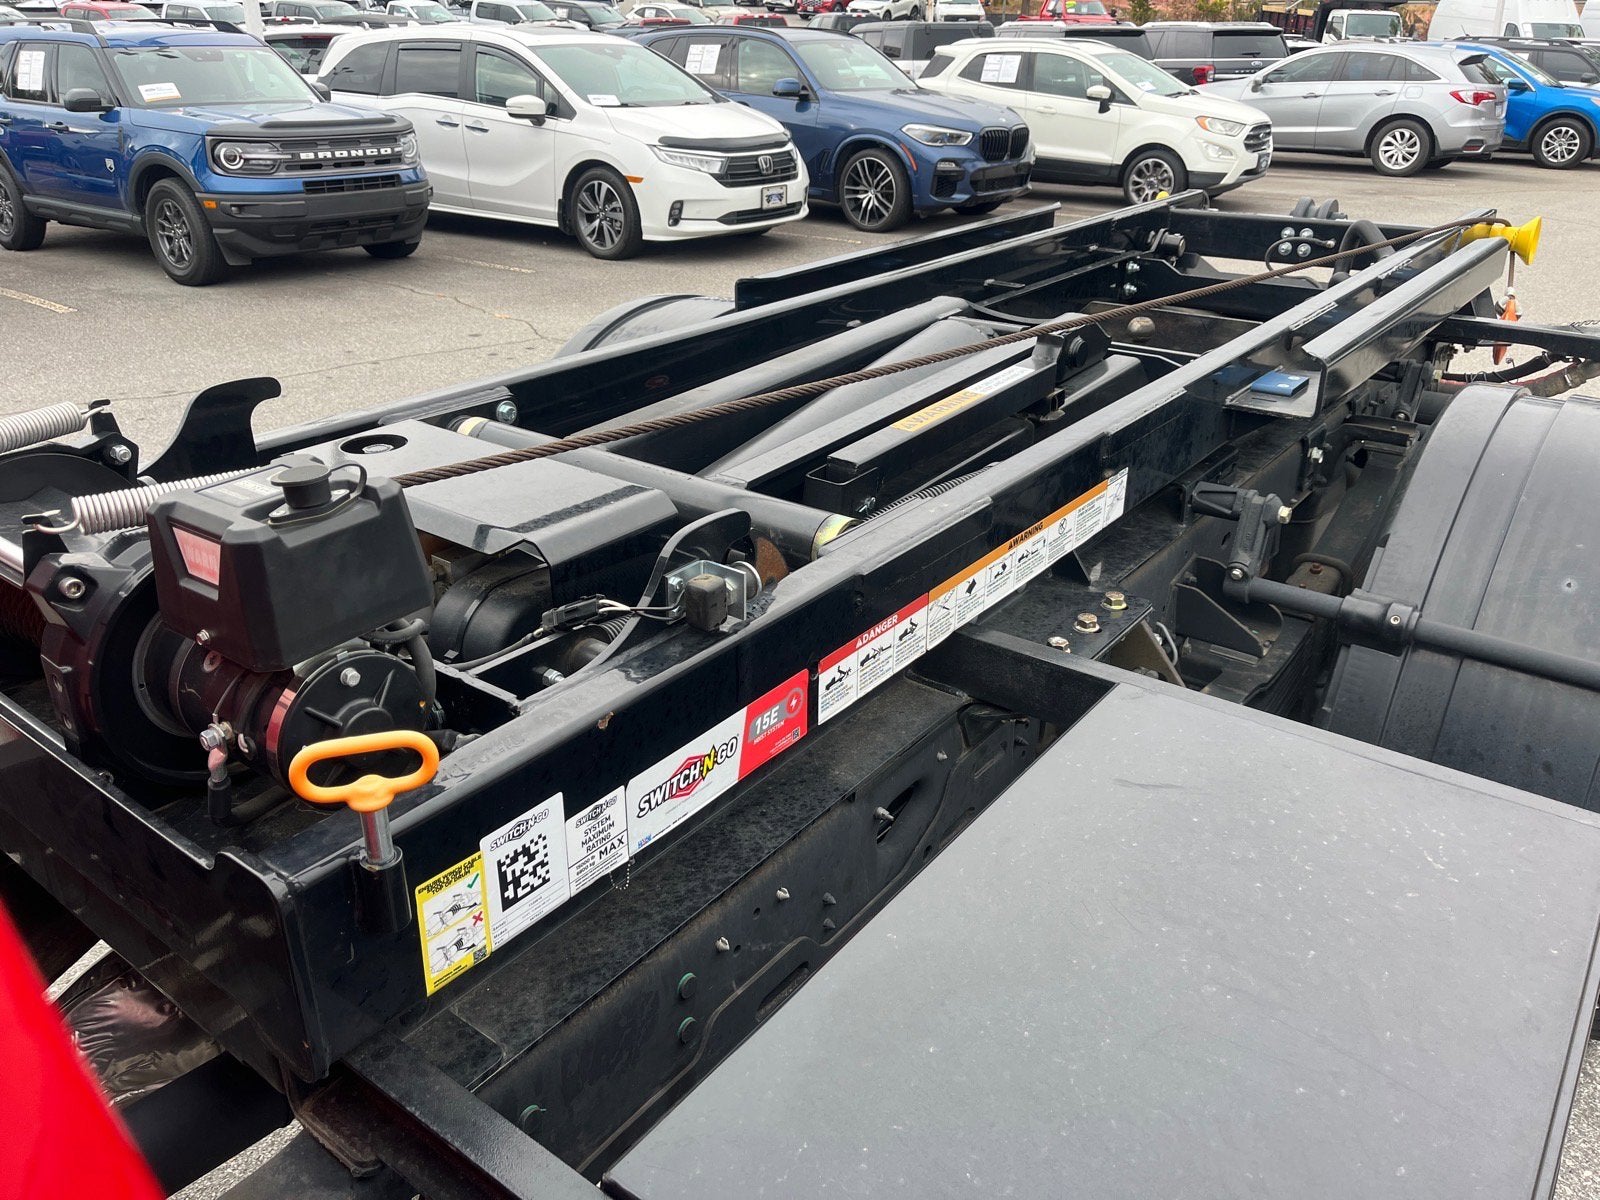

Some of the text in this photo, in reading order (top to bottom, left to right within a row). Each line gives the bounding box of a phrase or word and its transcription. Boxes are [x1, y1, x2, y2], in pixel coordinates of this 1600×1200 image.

[299, 147, 392, 160] BRONCO
[1012, 521, 1044, 548] WARNING
[862, 614, 898, 643] DANGER
[755, 705, 780, 735] 15E
[581, 820, 615, 848] MAXIMUM
[584, 814, 611, 837] SYSTEM
[586, 832, 611, 853] RATING
[599, 834, 624, 860] MAX
